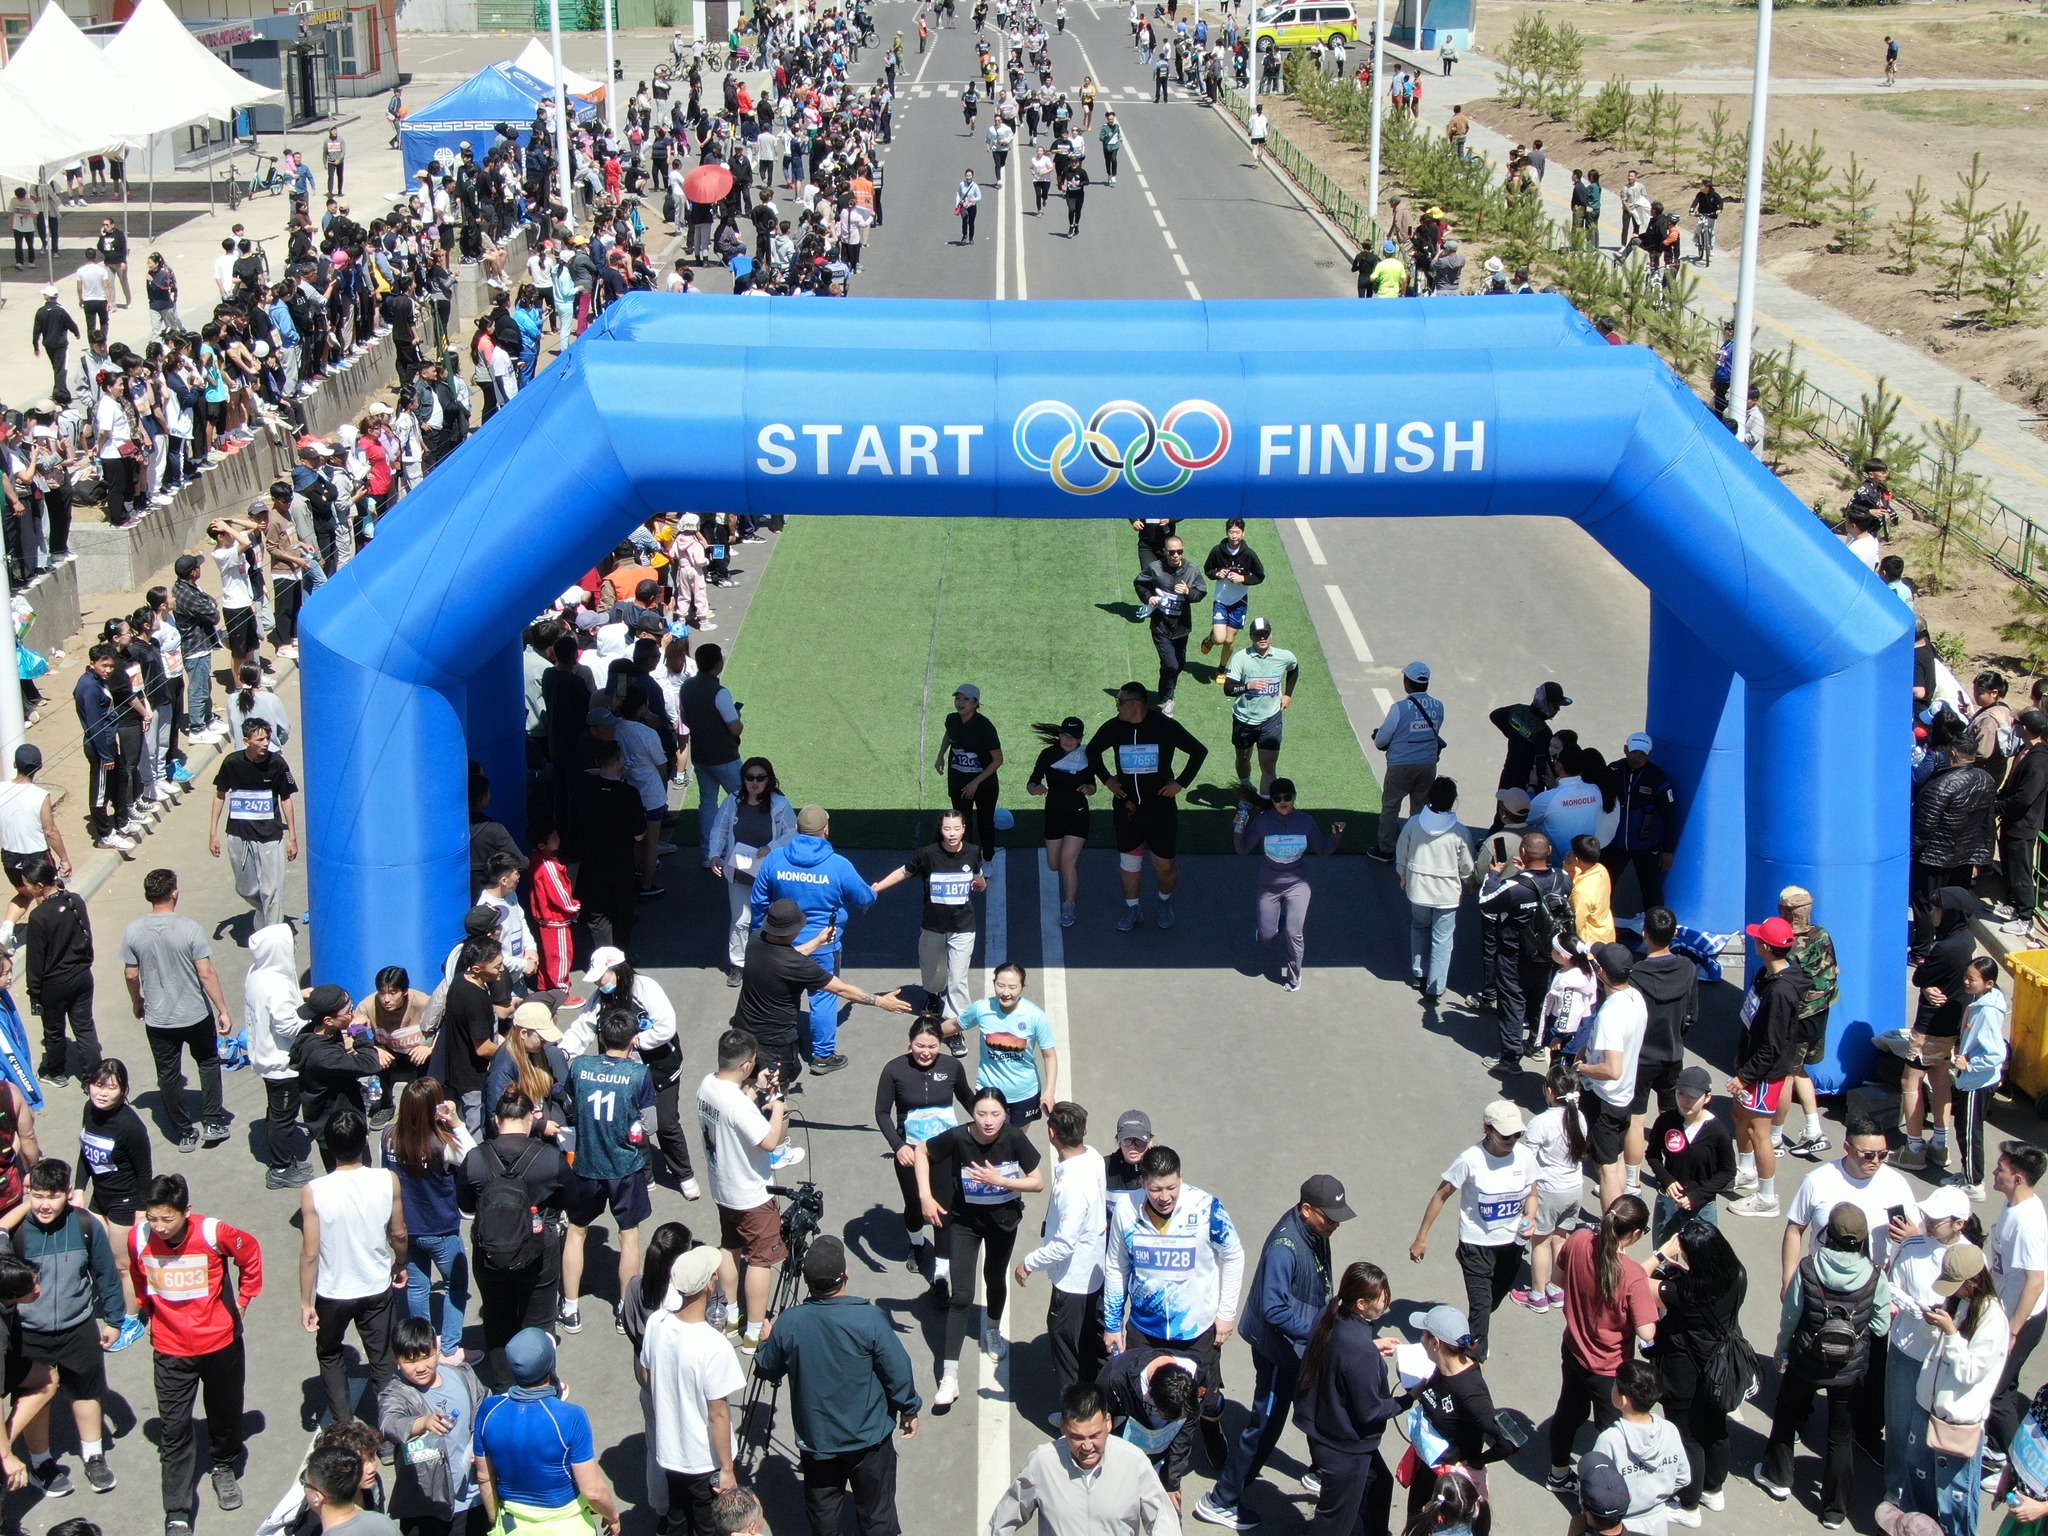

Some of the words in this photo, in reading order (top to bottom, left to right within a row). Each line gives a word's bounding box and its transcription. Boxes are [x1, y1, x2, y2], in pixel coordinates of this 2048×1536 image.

[756, 423, 984, 475] START
[1258, 420, 1485, 476] FINISH
[1132, 754, 1157, 766] 7655
[244, 800, 271, 811] 2473
[1562, 797, 1597, 807] MONGOLIA
[777, 870, 830, 885] MONGOLIA
[945, 882, 970, 895] 1870
[580, 1070, 631, 1086] BILGUUN
[587, 1089, 616, 1122] 11
[84, 1145, 109, 1164] 2193
[1154, 1250, 1191, 1268] 1728
[163, 1269, 205, 1288] 6033
